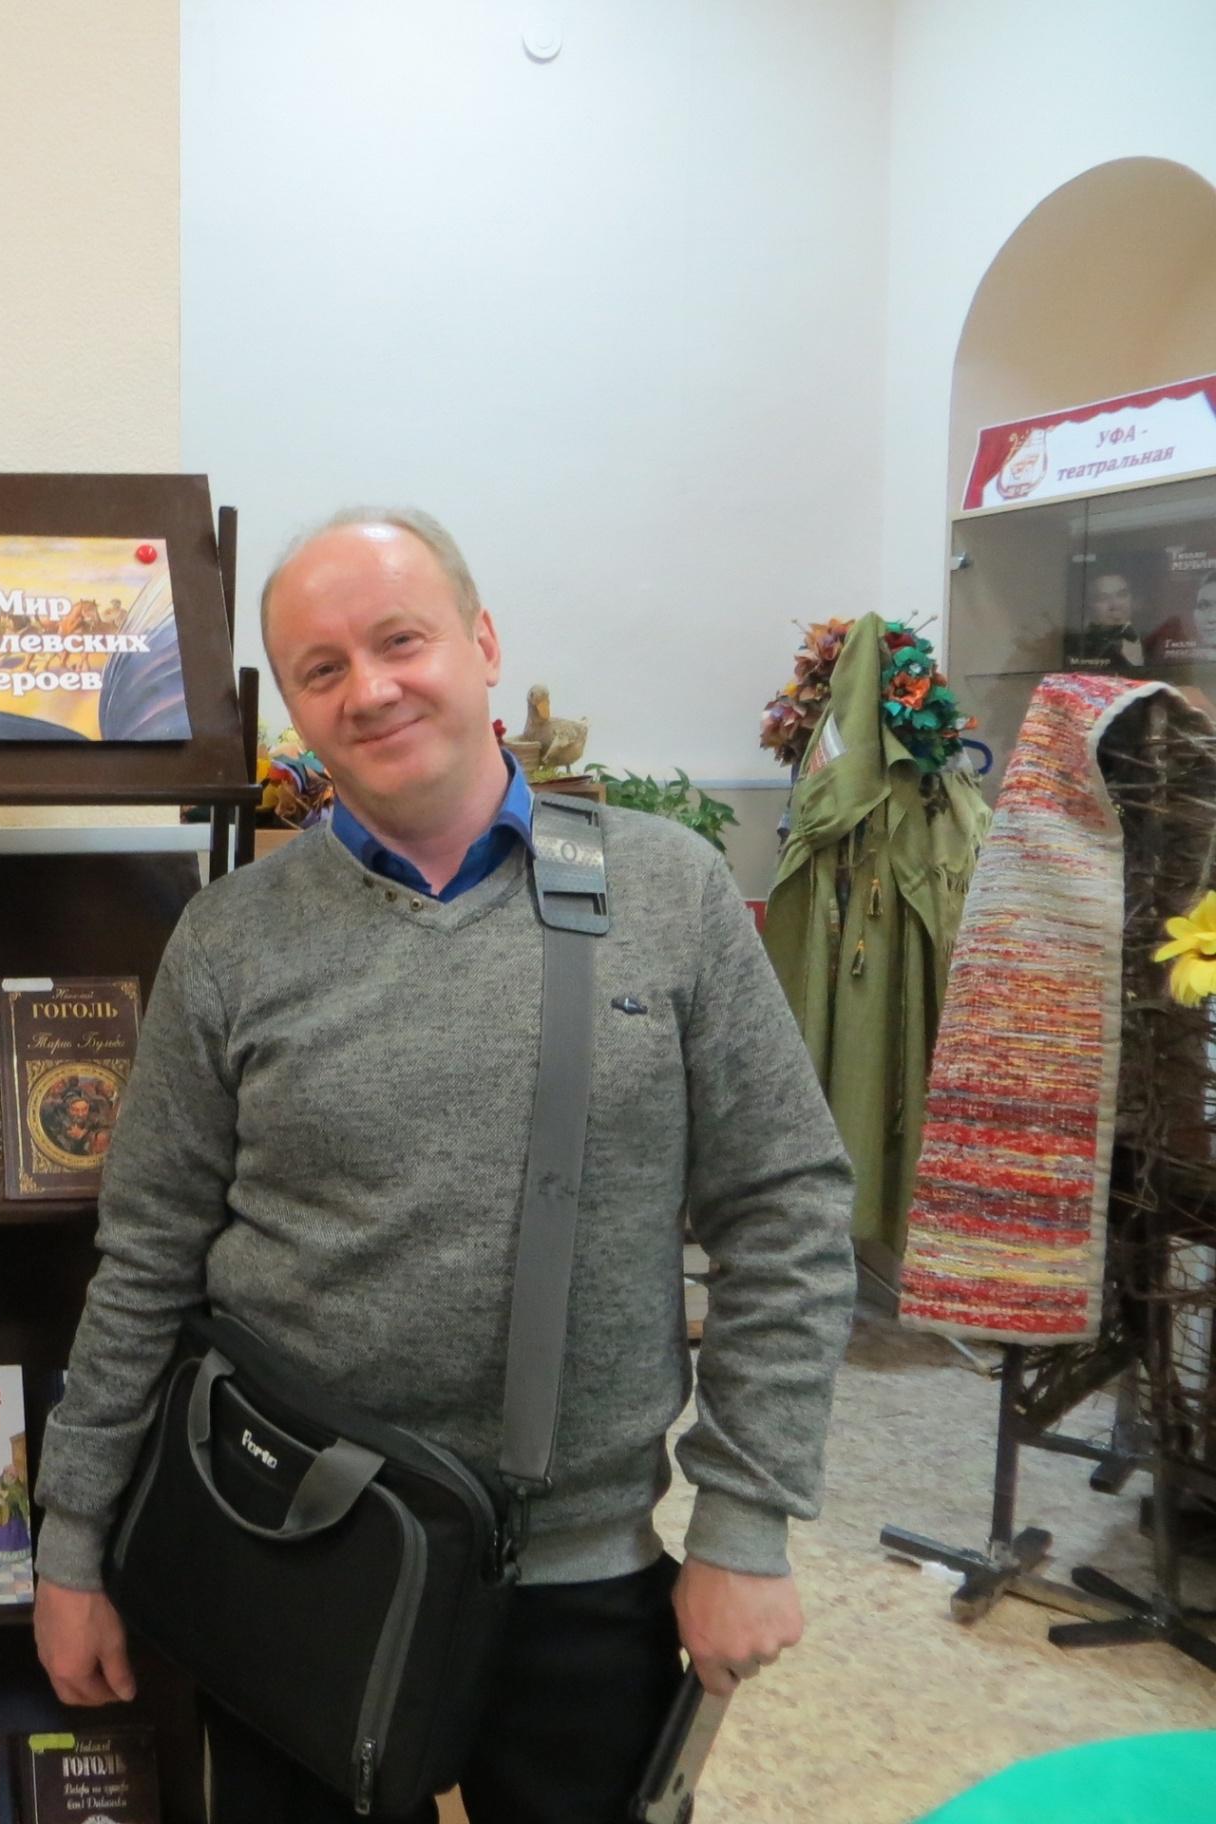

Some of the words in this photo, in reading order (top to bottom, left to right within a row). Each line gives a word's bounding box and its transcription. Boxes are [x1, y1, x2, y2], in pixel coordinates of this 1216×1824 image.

[1096, 424, 1136, 447] УФА
[1057, 446, 1175, 481] театральная
[33, 1002, 119, 1019] ГОГОЛЬ
[241, 1429, 278, 1469] Porto
